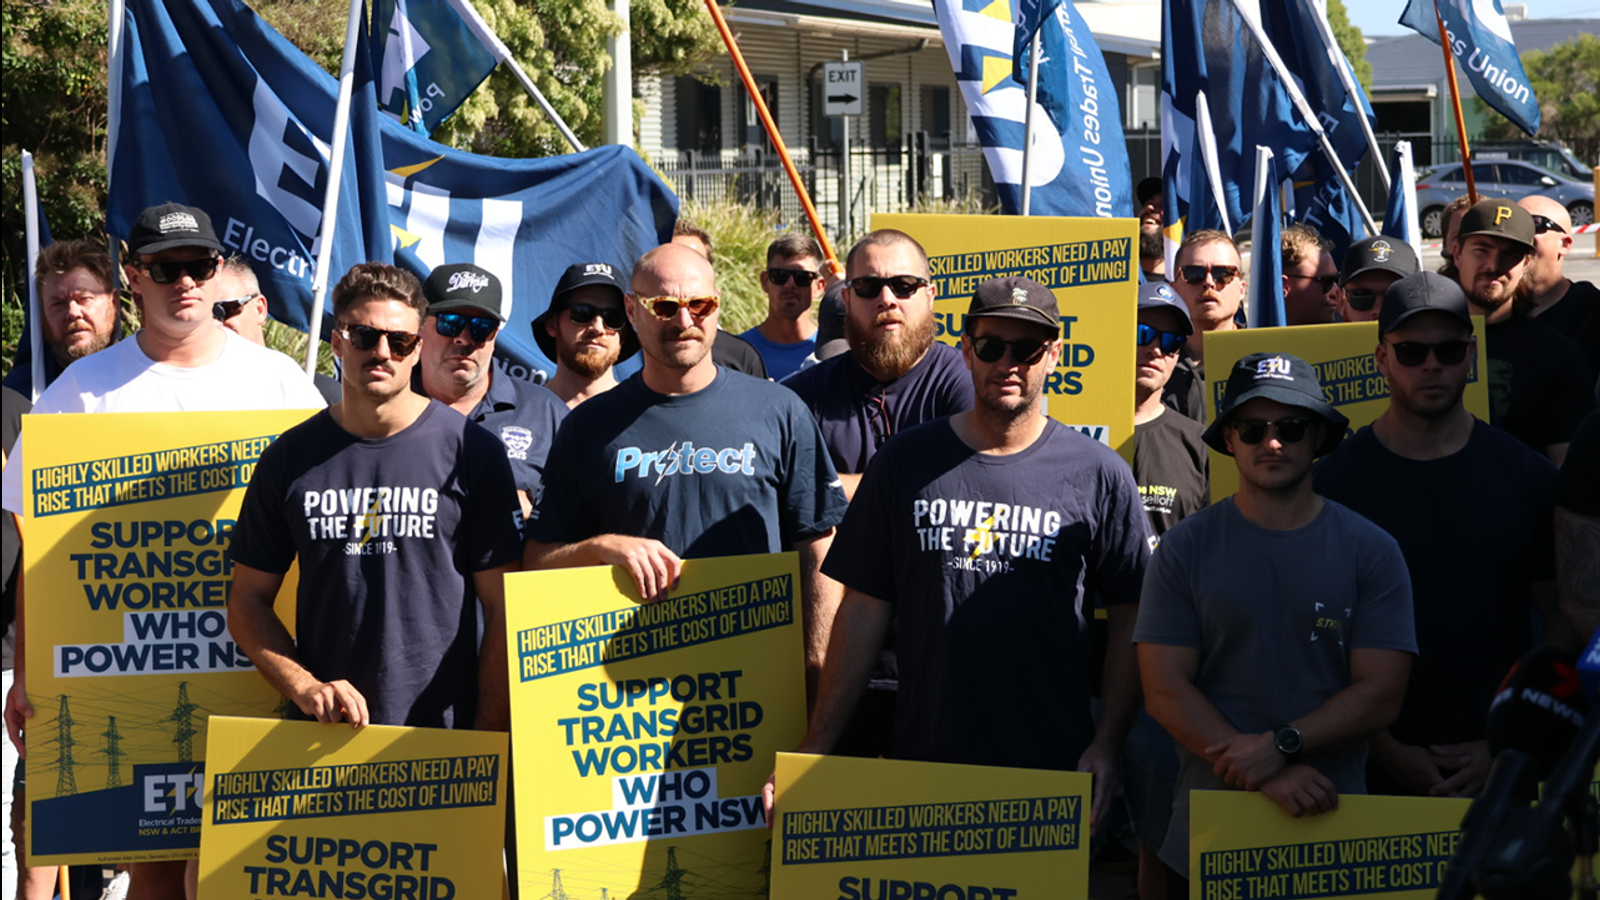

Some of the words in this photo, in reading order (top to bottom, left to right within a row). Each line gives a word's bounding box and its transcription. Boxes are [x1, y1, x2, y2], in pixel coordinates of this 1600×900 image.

[828, 70, 857, 83] EXIT
[1468, 47, 1530, 104] Union
[1495, 206, 1512, 225] P
[929, 254, 982, 276] SKILLED
[985, 247, 1050, 271] WORKERS
[1052, 243, 1088, 263] NEED
[1090, 242, 1100, 260] A
[1102, 239, 1128, 259] PAY
[1060, 265, 1077, 285] OF
[1080, 260, 1126, 282] LIVING!
[504, 355, 548, 386] ion
[1257, 358, 1291, 374] ETU
[1336, 379, 1364, 402] THE
[36, 463, 90, 489] HIGHLY
[91, 454, 153, 482] SKILLED
[155, 443, 228, 472] WORKERS
[615, 441, 756, 486] Protect
[38, 492, 71, 513] RISE
[73, 484, 112, 508] THAT
[114, 476, 166, 502] MEETS
[168, 472, 197, 494] THE
[200, 465, 238, 490] COST
[303, 487, 439, 517] POWERING
[1149, 485, 1177, 498] NSW
[90, 519, 237, 549] SUPPOR
[307, 516, 348, 540] THE
[354, 514, 436, 540] FUTURE
[913, 498, 1061, 538] POWERING
[917, 527, 955, 551] THE
[963, 527, 1056, 562] FUTURE
[83, 580, 233, 611] WORKE
[521, 621, 573, 652] HIGHLY
[575, 608, 635, 641] SKILLED
[636, 593, 707, 627] WORKERS
[709, 585, 748, 612] NEED
[750, 582, 761, 603] A
[762, 576, 789, 600] PAY
[130, 611, 226, 640] WHO
[523, 651, 556, 678] RISE
[558, 642, 597, 668] THAT
[599, 631, 649, 660] MEETS
[651, 625, 679, 650] THE
[681, 615, 717, 642] COST
[719, 611, 738, 634] OF
[740, 600, 790, 630] LIVING!
[61, 643, 200, 674] POWER
[209, 641, 255, 668] NS
[577, 669, 743, 712] SUPPORT
[557, 701, 763, 746] TRANSGRID
[571, 733, 754, 777] WORKERS
[217, 772, 272, 796] HIGHLY
[272, 767, 332, 792] SKILLED
[335, 761, 408, 788] WORKERS
[411, 759, 451, 782] NEED
[452, 759, 464, 779] A
[467, 756, 496, 778] PAY
[619, 770, 711, 806] WHO
[216, 798, 249, 821] RISE
[252, 795, 291, 818] THAT
[293, 791, 343, 816] MEETS
[346, 789, 374, 812] THE
[378, 786, 416, 809] COST
[418, 784, 438, 806] OF
[440, 781, 493, 805] LIVING!
[786, 811, 841, 834] HIGHLY
[843, 807, 906, 831] SKILLED
[909, 802, 985, 828] WORKERS
[988, 800, 1030, 823] NEED
[1032, 799, 1044, 821] A
[1047, 797, 1078, 820] PAY
[139, 818, 175, 828] Electrical
[139, 828, 160, 837] NSW
[170, 826, 188, 835] ACT
[552, 805, 687, 846] POWER
[265, 834, 437, 871] SUPPORT
[786, 838, 820, 861] RISE
[823, 835, 863, 858] THAT
[865, 832, 918, 856] MEETS
[920, 830, 950, 852] THE
[953, 828, 994, 851] COST
[997, 827, 1016, 849] OF
[1019, 823, 1076, 847] LIVING!
[1205, 849, 1264, 876] HIGHLY
[1267, 842, 1336, 870] SKILLED
[1338, 835, 1423, 864] WORKERS
[244, 865, 456, 900] TRANSGRID
[1206, 878, 1243, 900] RISE
[1246, 874, 1289, 899] THAT
[1292, 868, 1350, 894] MEETS
[1353, 865, 1386, 890] THE
[1389, 861, 1433, 886] COST
